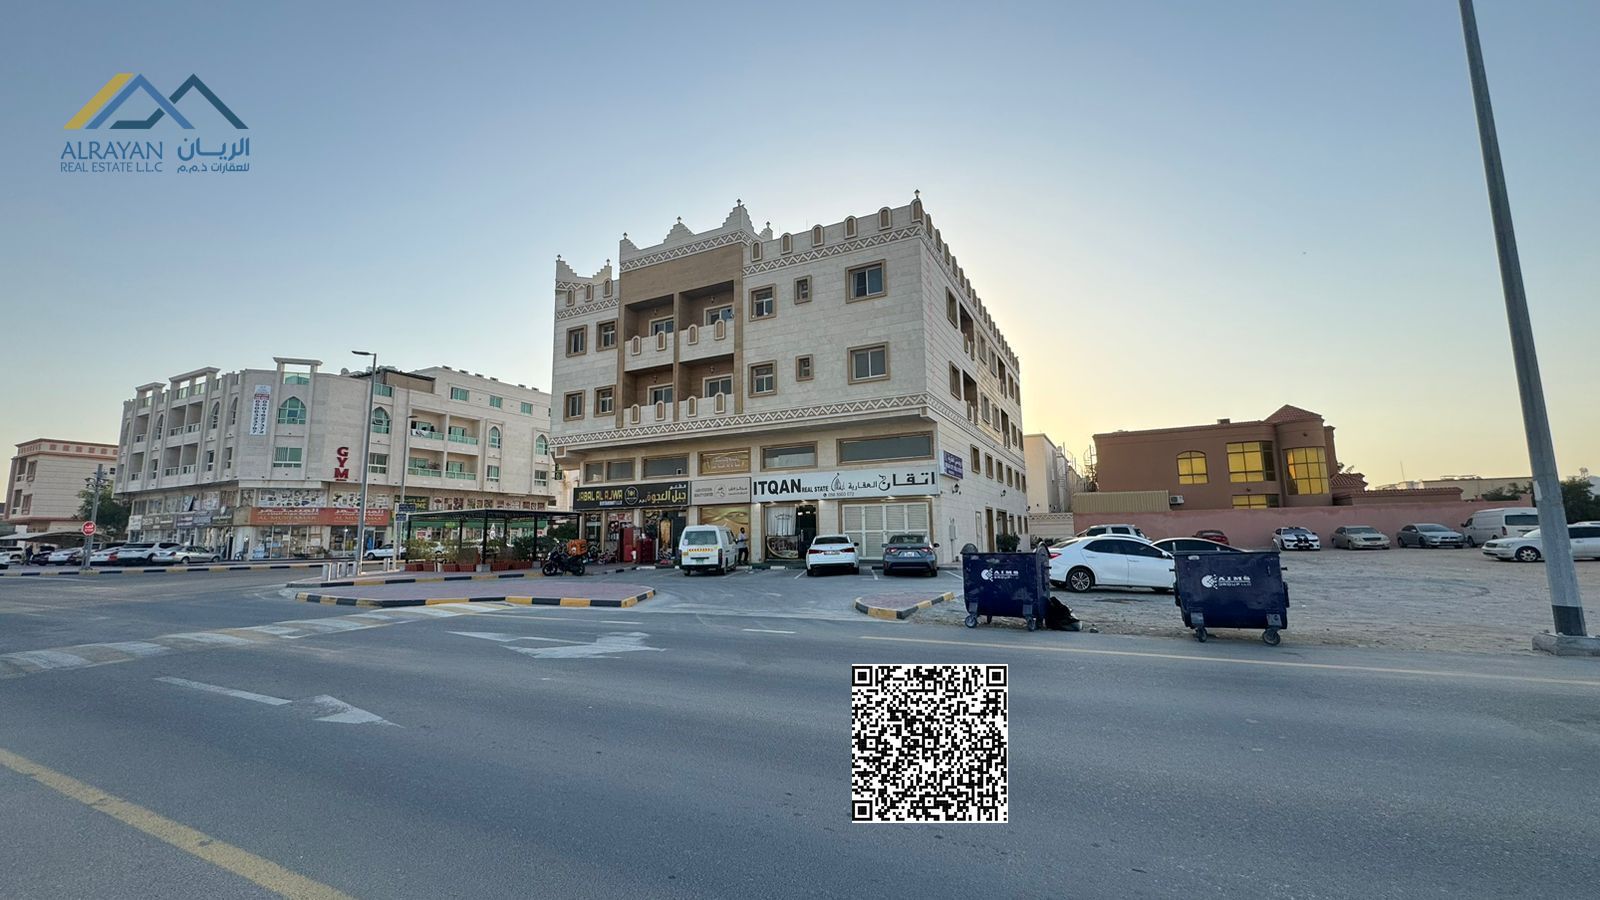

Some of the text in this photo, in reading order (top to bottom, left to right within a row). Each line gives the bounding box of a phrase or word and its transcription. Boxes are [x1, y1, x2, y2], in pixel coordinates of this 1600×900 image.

[334, 446, 349, 479] GYM
[753, 479, 801, 495] ITQAN
[848, 481, 878, 491] العقارية
[577, 488, 623, 502] JABAL AL AJWA
[646, 490, 671, 504] العجوة
[671, 489, 686, 503] جبل
